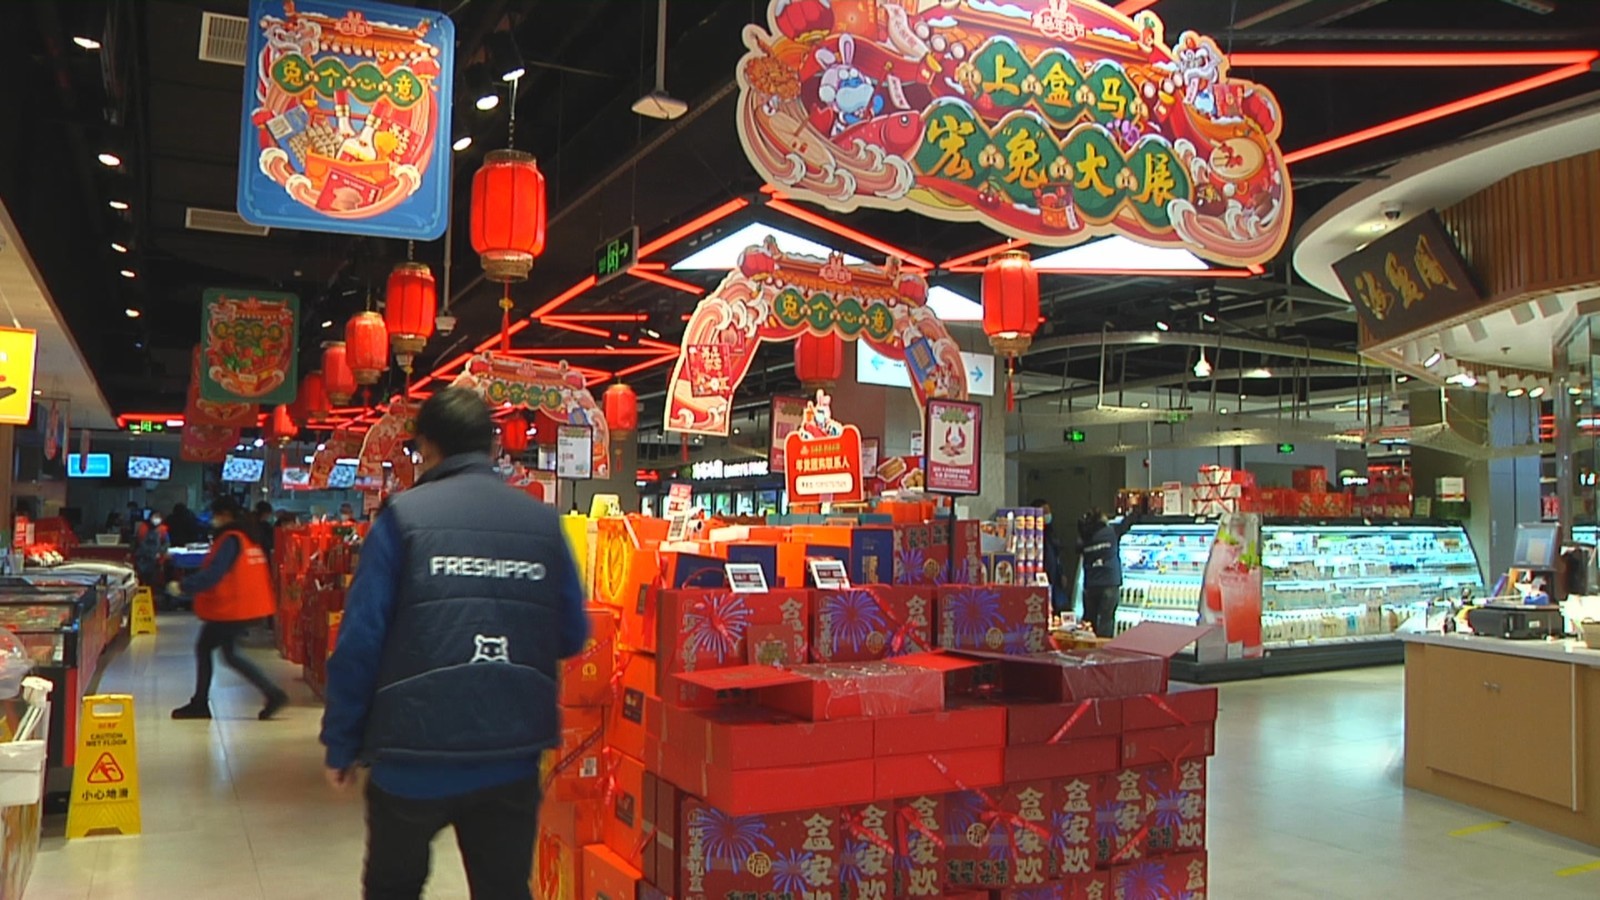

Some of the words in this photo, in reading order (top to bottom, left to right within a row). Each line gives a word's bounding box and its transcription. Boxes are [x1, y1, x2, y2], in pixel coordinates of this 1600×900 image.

[283, 61, 415, 100] 兔个心意
[982, 54, 1127, 119] 上盒马
[782, 294, 887, 333] 兔个心意
[430, 556, 546, 580] FRESHIPPO
[82, 788, 128, 801] 小心地滑
[1177, 760, 1204, 847] 盒家欢
[1014, 787, 1045, 884] 盒家欢
[1061, 779, 1092, 874] 盒家欢
